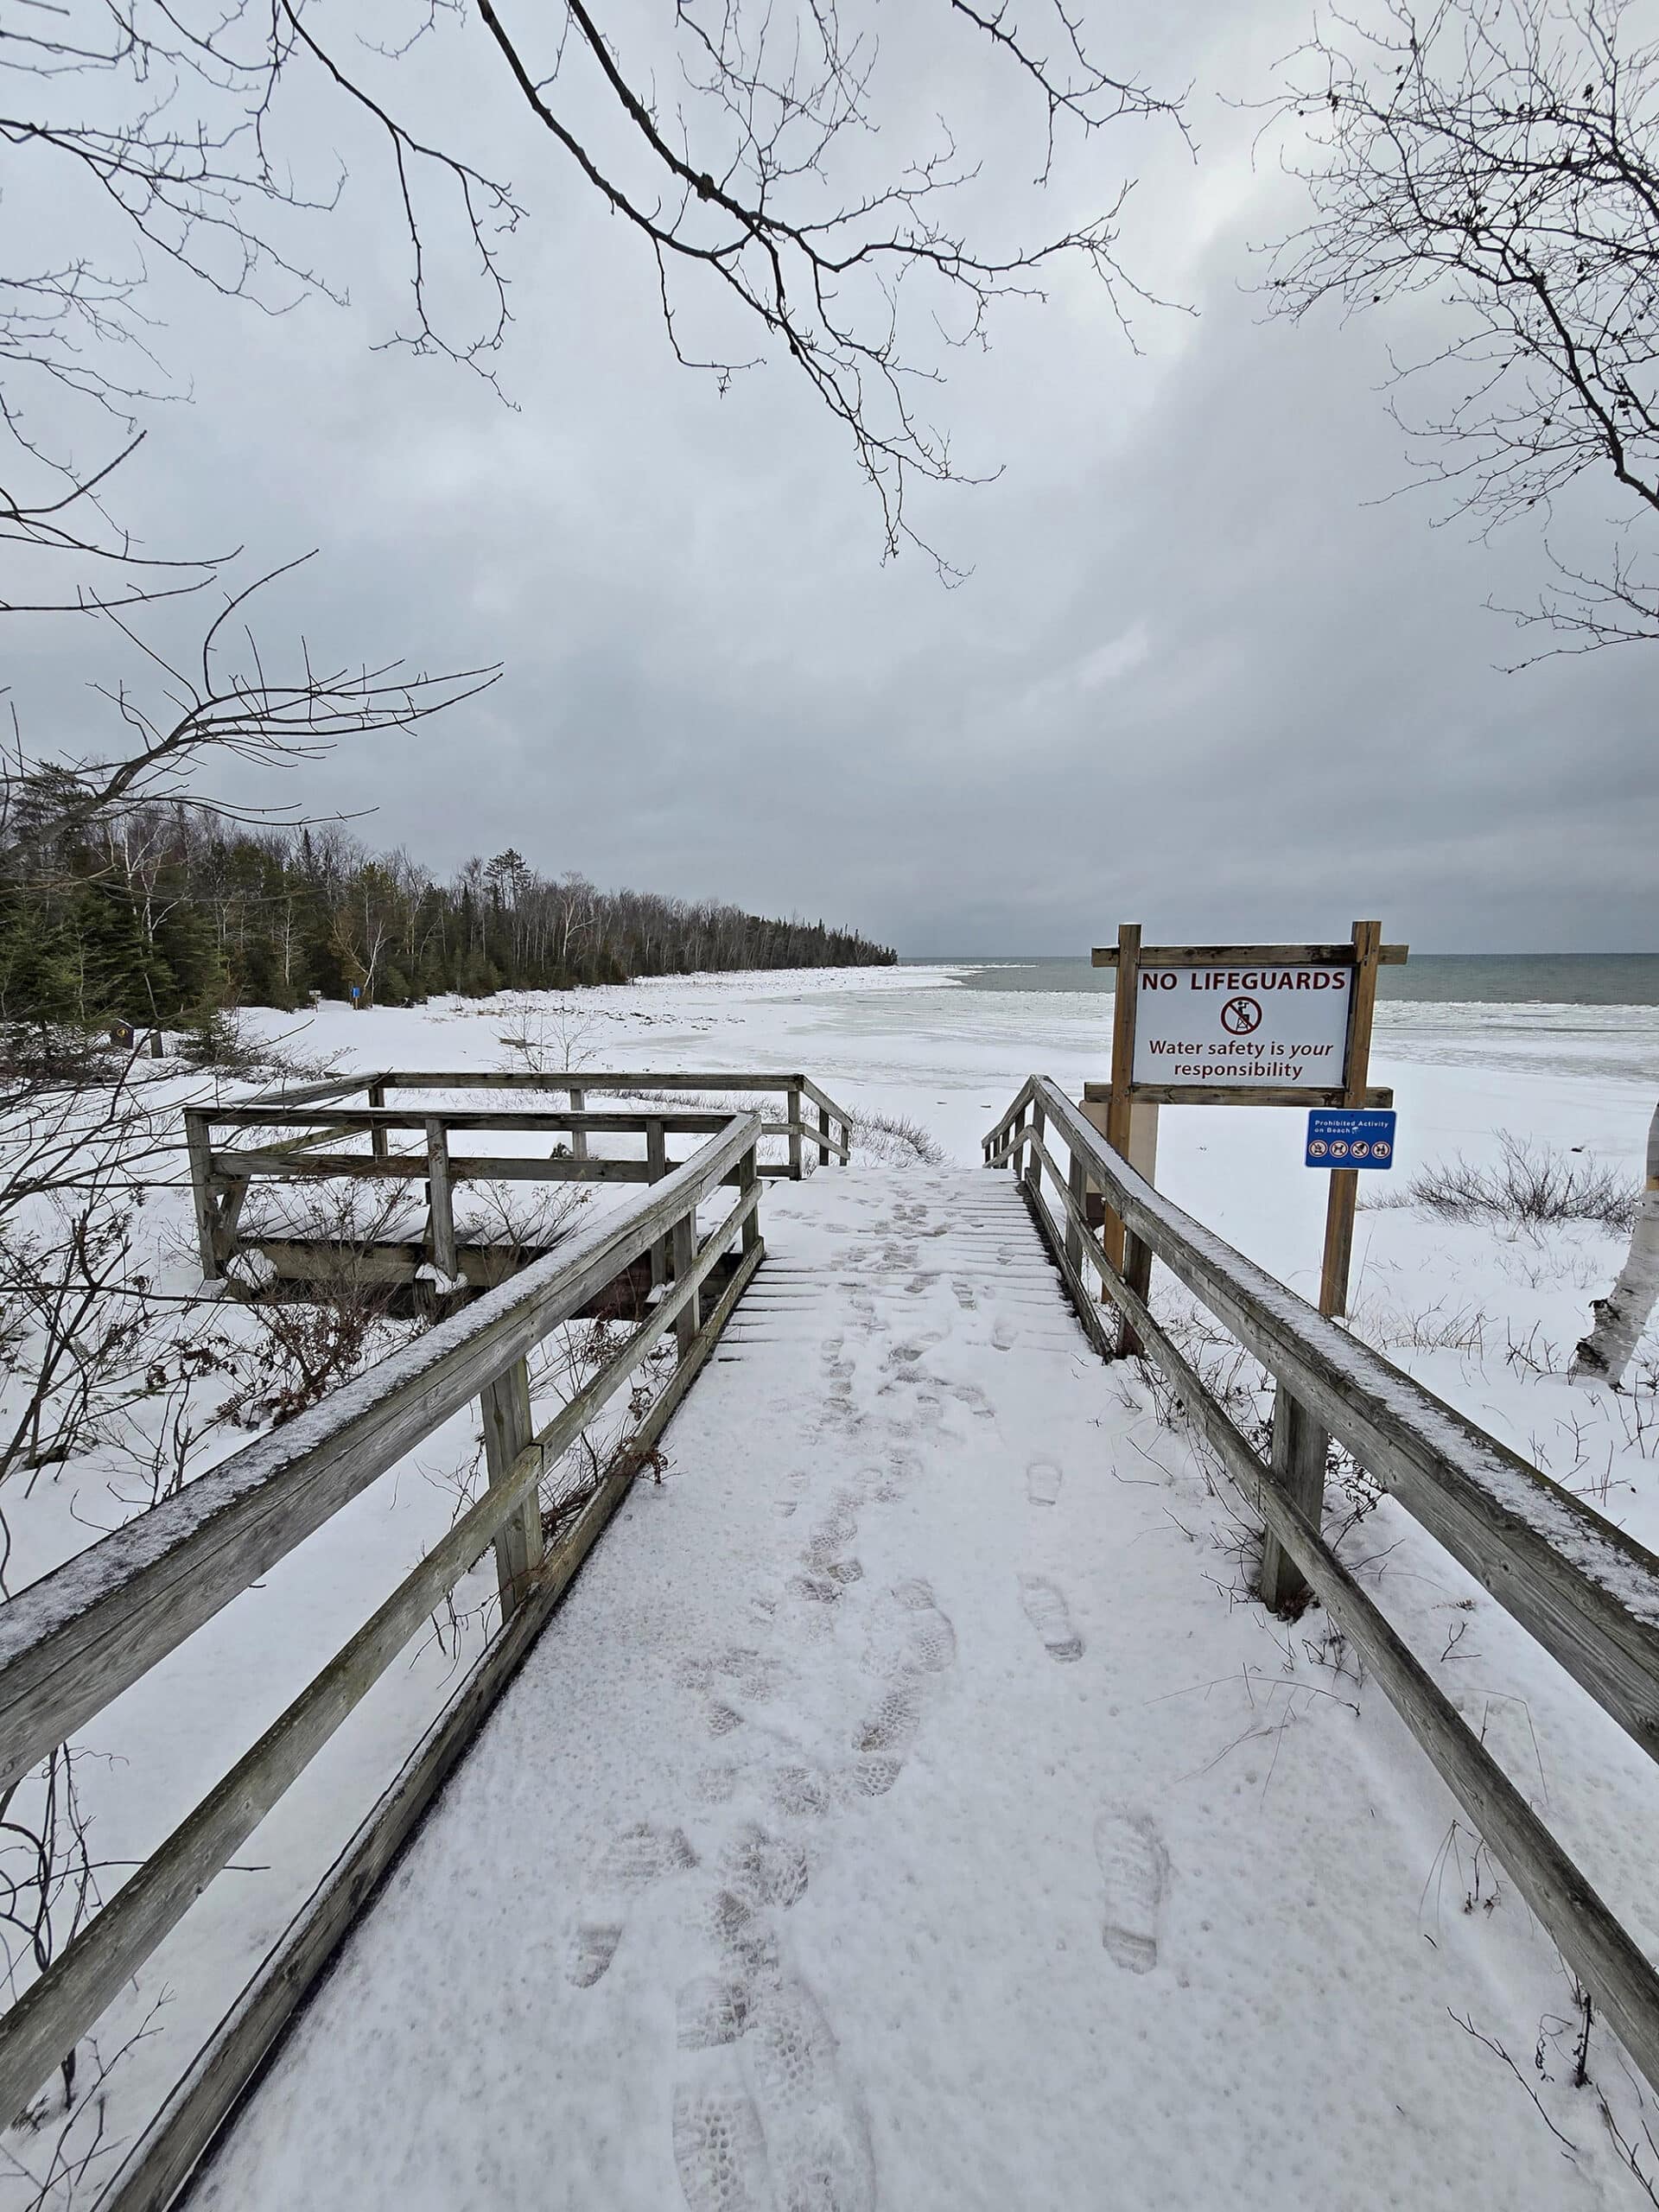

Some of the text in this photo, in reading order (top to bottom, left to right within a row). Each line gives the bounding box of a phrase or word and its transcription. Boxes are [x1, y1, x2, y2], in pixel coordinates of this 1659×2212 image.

[1142, 972, 1345, 990] NO LIFEGUARDS
[1149, 1040, 1334, 1058] Water safety is your
[1174, 1063, 1303, 1080] responsibility
